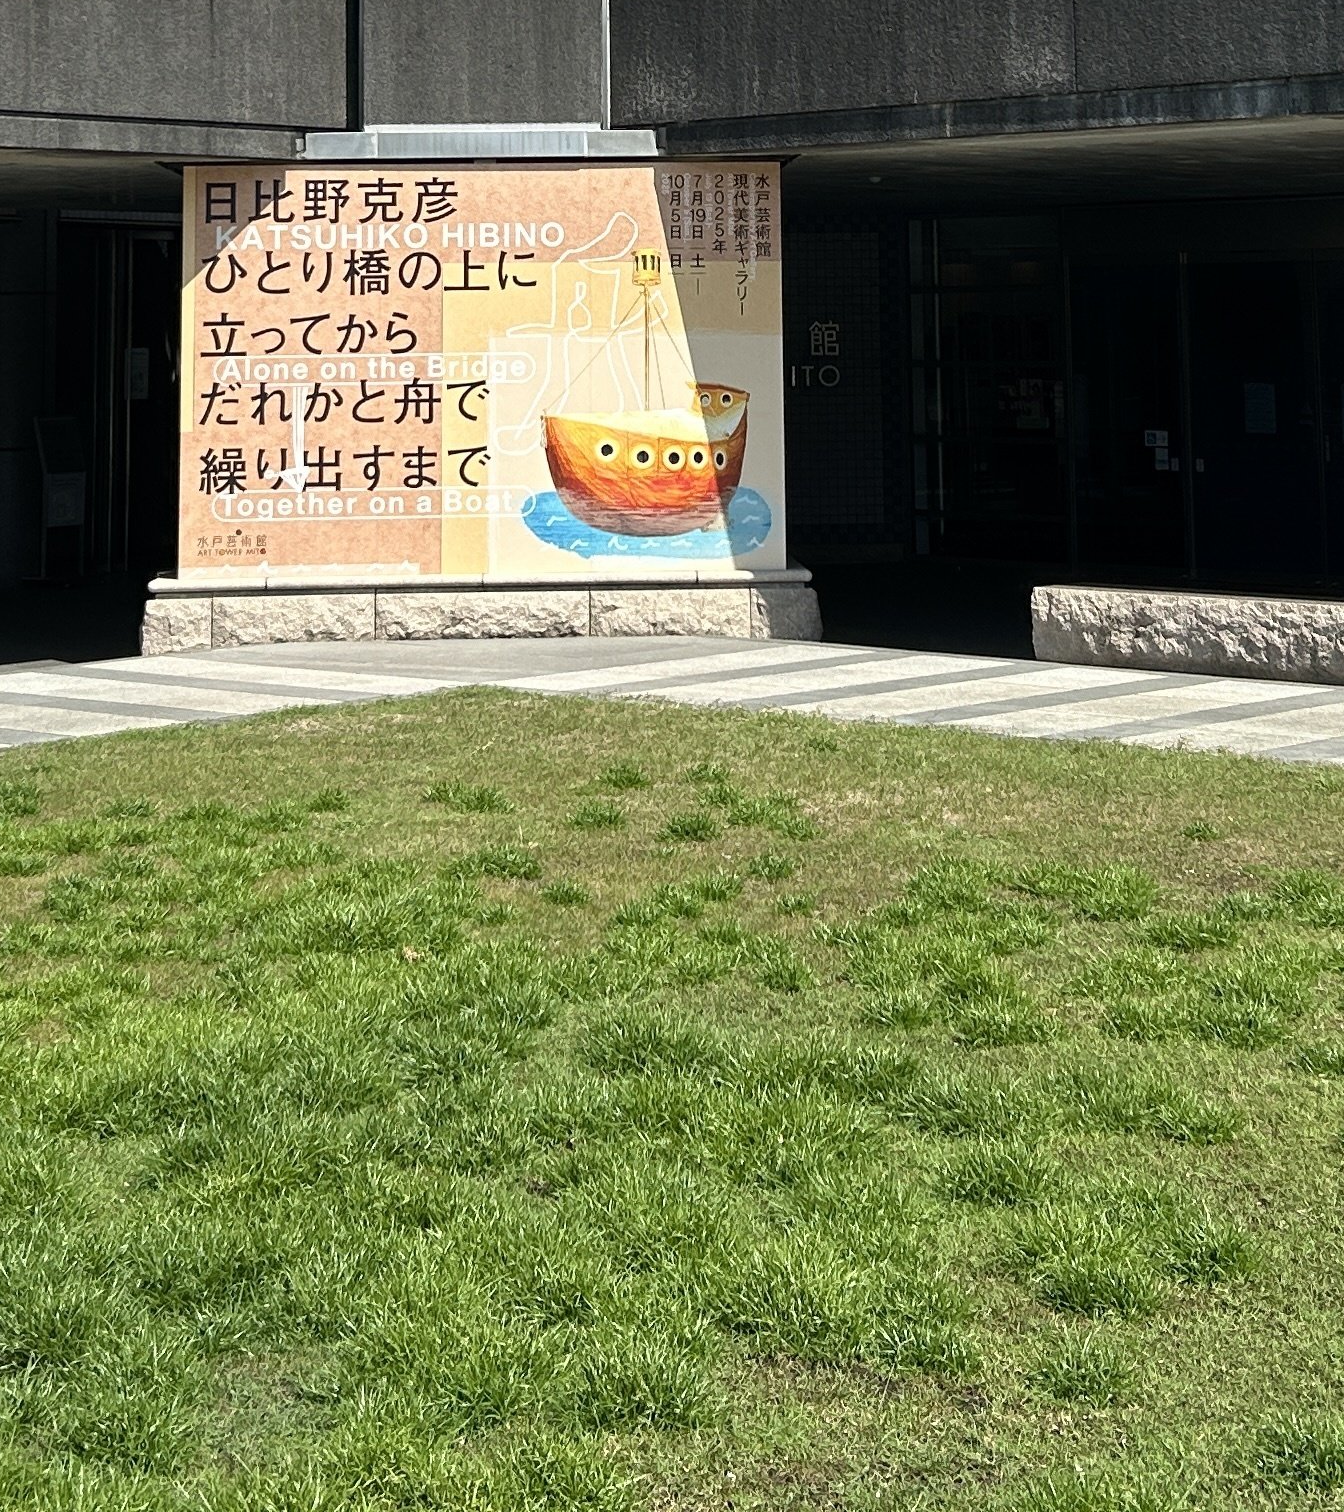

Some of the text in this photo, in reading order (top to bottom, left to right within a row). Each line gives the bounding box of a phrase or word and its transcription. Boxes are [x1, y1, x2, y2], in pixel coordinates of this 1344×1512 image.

[205, 177, 459, 224] 日比野克彦
[712, 174, 728, 254] 2025年
[755, 173, 772, 257] 水戸芸術館
[215, 222, 565, 251] KATSUHIKO HIBINO
[733, 173, 750, 316] 現代美術ギャラリー
[202, 249, 538, 295] ひとり橋の上に
[200, 312, 418, 357] 立ってから
[220, 357, 526, 383] Alone on the Bridge
[199, 377, 490, 426] だれかと舟で
[199, 445, 491, 495] 繰り出すまで
[222, 490, 514, 519] Together on a Boat
[197, 549, 212, 557] ART
[216, 548, 242, 556] TOWER
